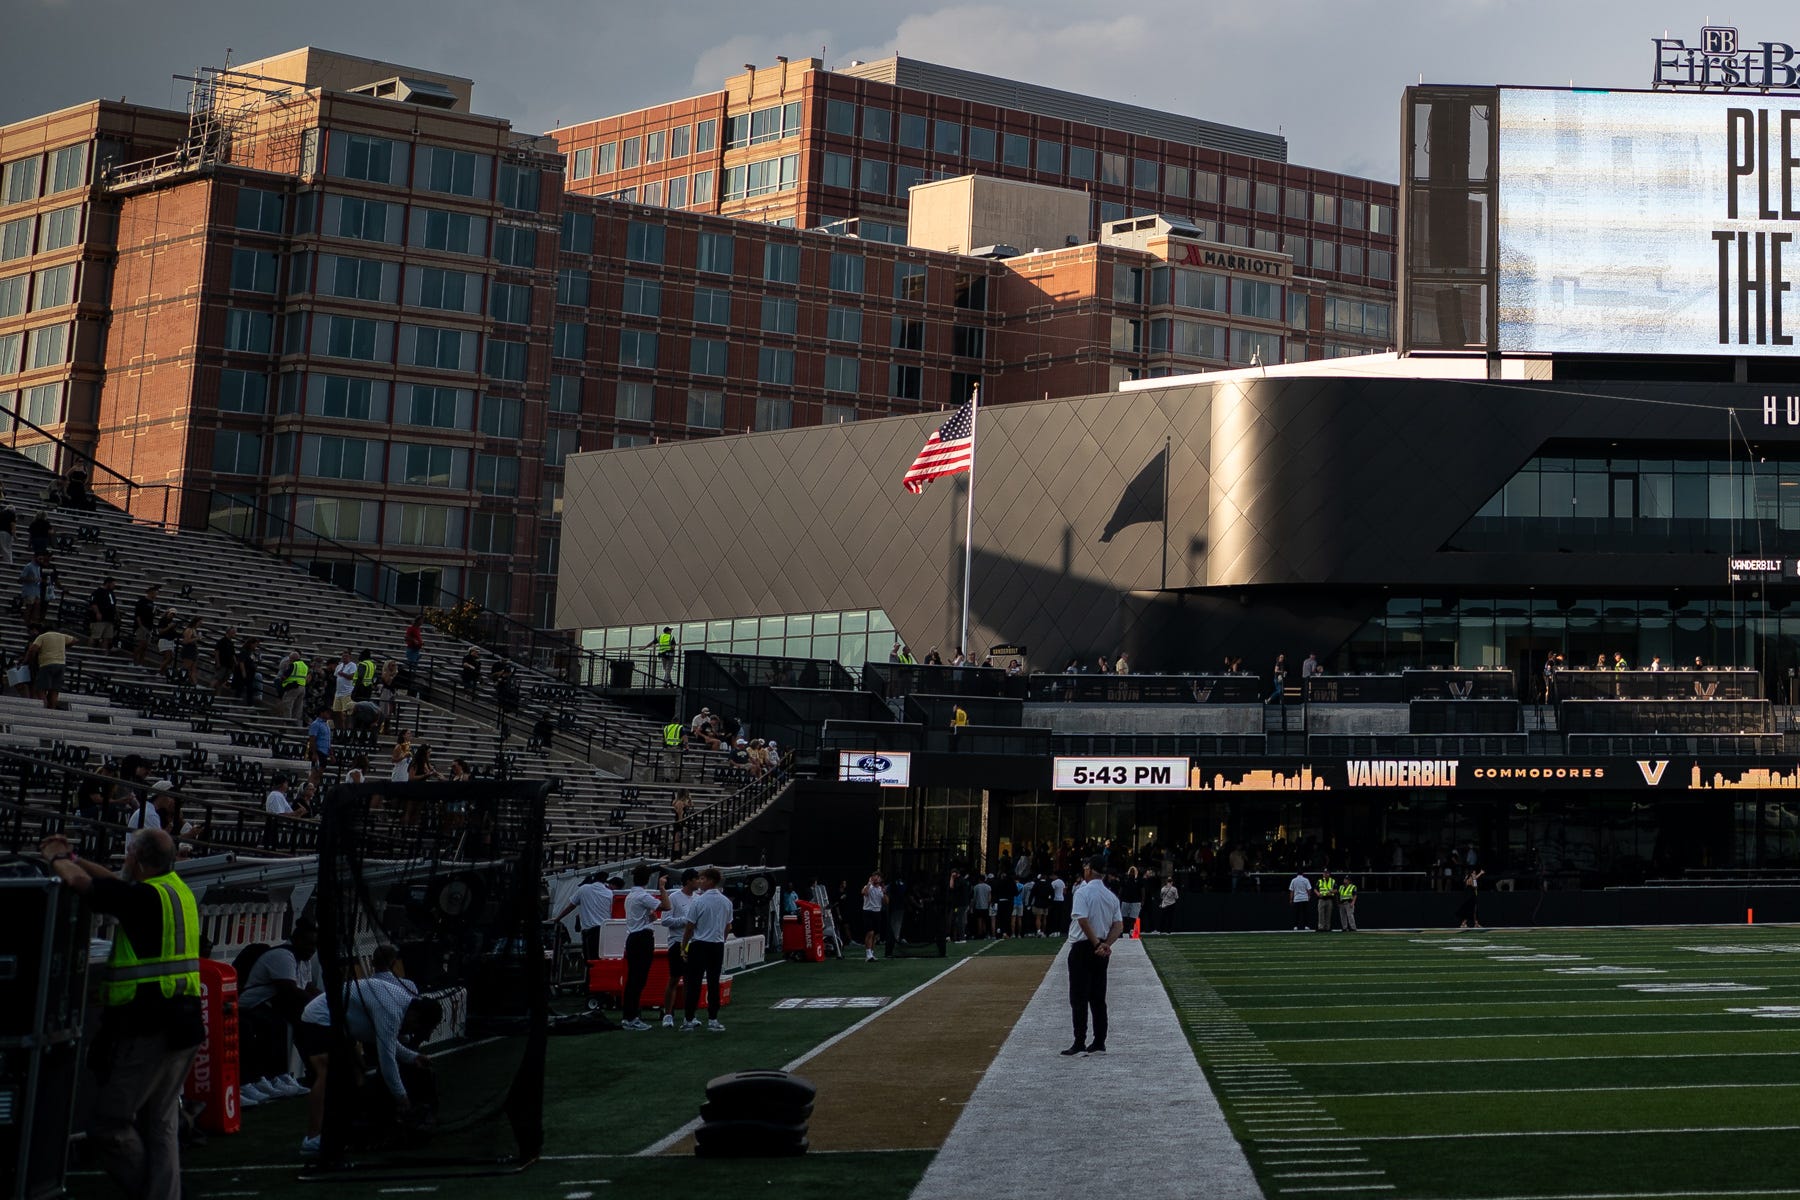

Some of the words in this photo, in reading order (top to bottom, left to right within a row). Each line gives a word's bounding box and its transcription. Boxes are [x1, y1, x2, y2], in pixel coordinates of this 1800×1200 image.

[1705, 31, 1735, 53] FB
[1205, 251, 1283, 277] MARRIOTT
[1712, 231, 1793, 345] THE
[1731, 560, 1781, 571] VANDERBILT
[1073, 766, 1128, 785] 5:43
[1134, 766, 1171, 785] PM
[1347, 760, 1459, 787] VANDERBILT
[1474, 767, 1605, 779] COMMODORES
